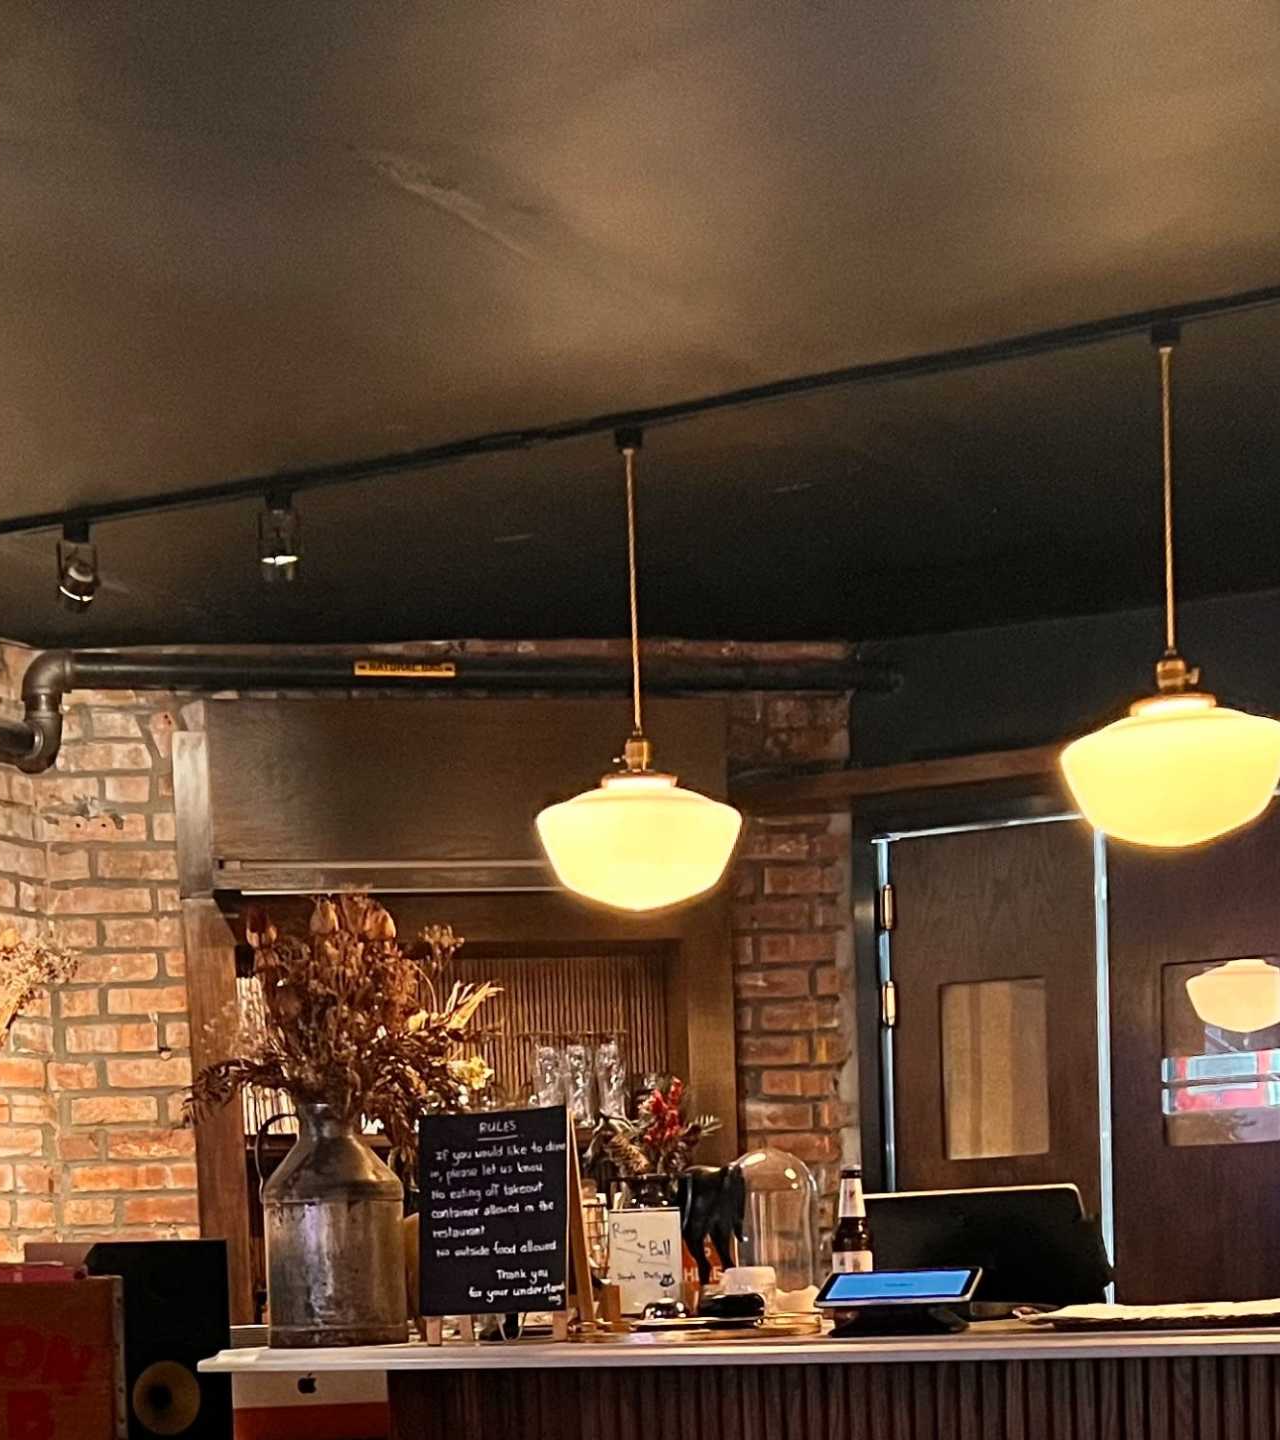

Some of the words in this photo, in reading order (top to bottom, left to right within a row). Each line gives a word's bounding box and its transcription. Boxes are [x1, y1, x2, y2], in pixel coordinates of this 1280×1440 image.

[479, 1120, 517, 1133] RULES
[452, 1152, 472, 1166] you
[475, 1144, 503, 1158] would
[506, 1144, 528, 1156] like
[530, 1141, 543, 1153] to
[446, 1167, 478, 1185] please
[482, 1163, 496, 1176] let
[500, 1165, 513, 1174] us
[517, 1161, 543, 1173] know
[450, 1187, 481, 1202] eating
[503, 1180, 544, 1196] takeout
[431, 1206, 479, 1219] container
[483, 1202, 520, 1216] allowed
[538, 1200, 554, 1212] the
[433, 1224, 485, 1239] restaurant
[454, 1245, 490, 1257] outside
[493, 1240, 516, 1254] food
[519, 1239, 557, 1253] allowed
[496, 1268, 527, 1280] Thank
[530, 1269, 548, 1285] you
[468, 1285, 482, 1298] for
[486, 1287, 509, 1303] your
